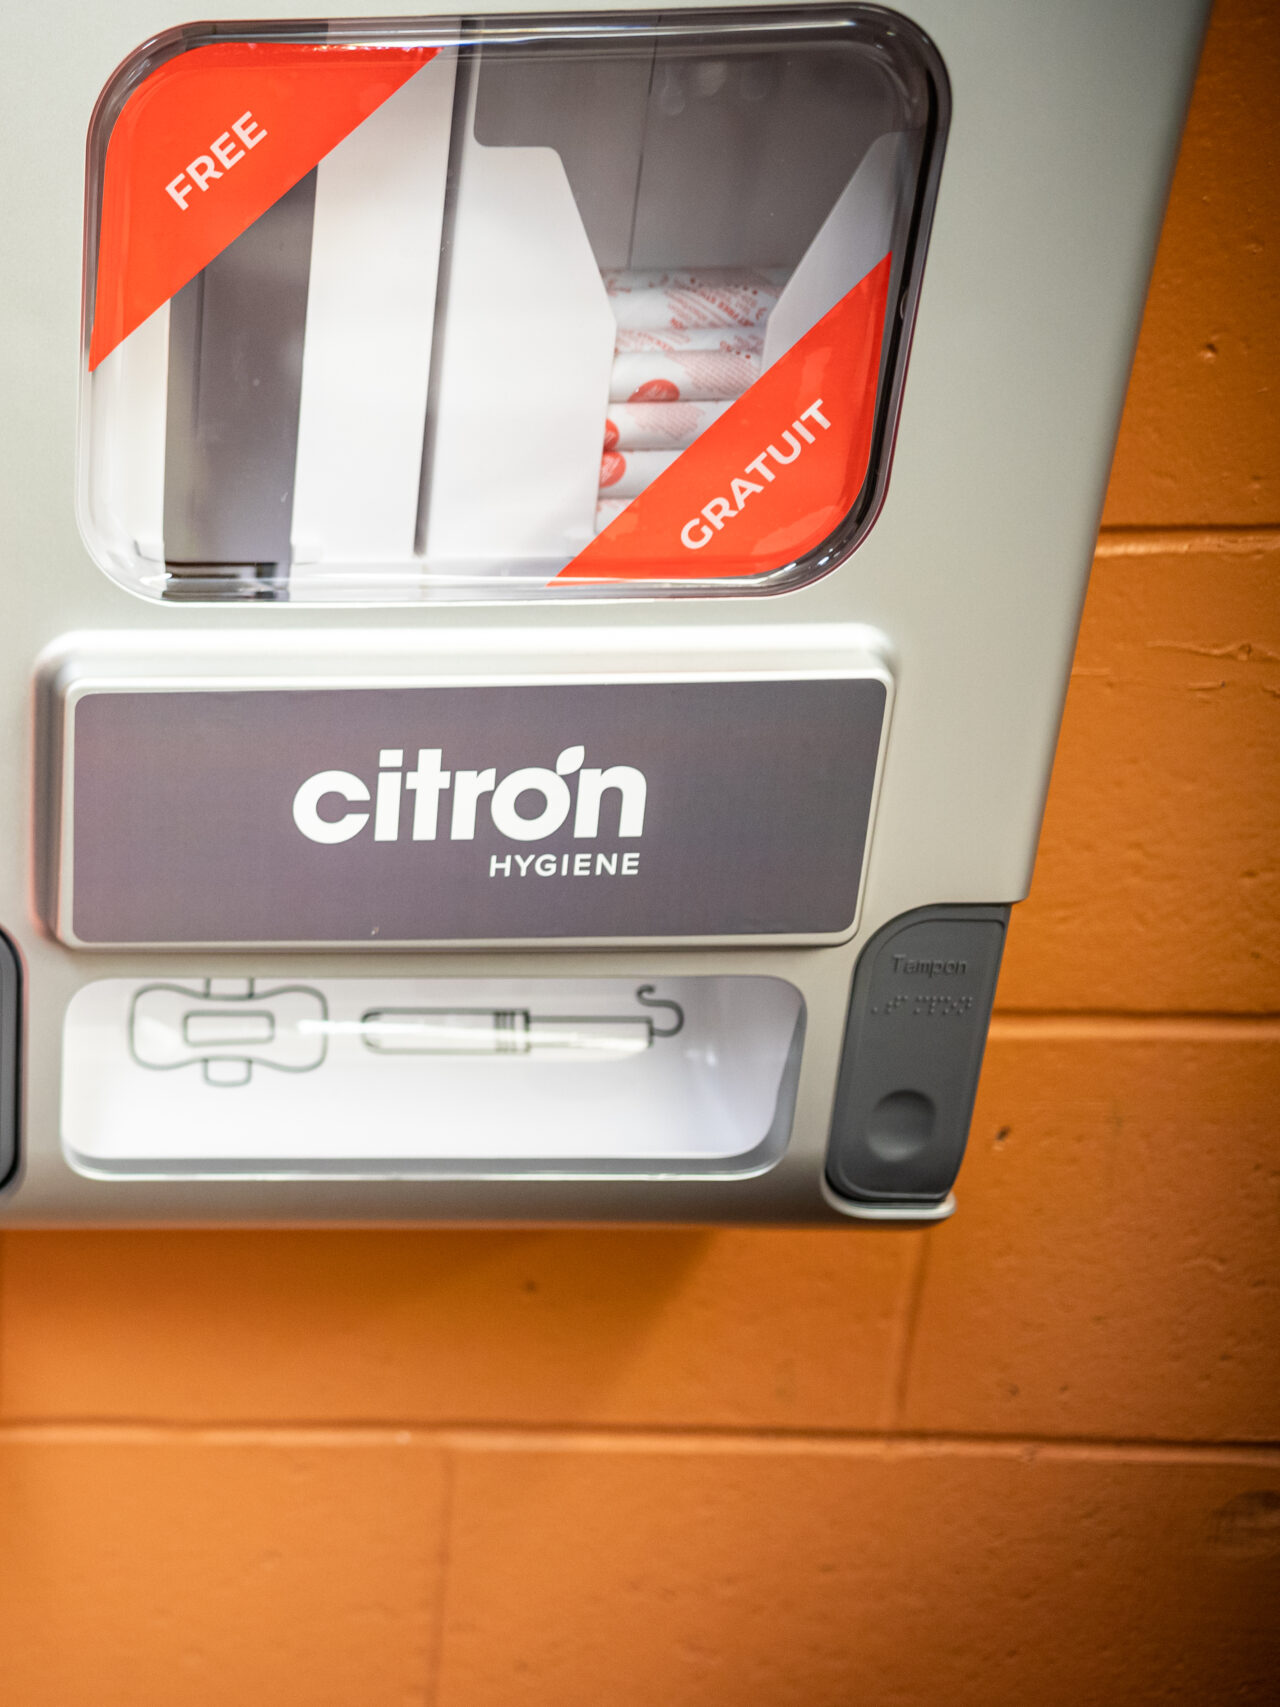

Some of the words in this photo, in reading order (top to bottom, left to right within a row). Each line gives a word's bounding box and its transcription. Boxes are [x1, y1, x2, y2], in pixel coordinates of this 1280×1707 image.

[165, 110, 269, 211] FREE
[680, 398, 832, 550] GRATUIT
[489, 852, 640, 878] HYGIENE
[891, 954, 967, 978] Tampon
